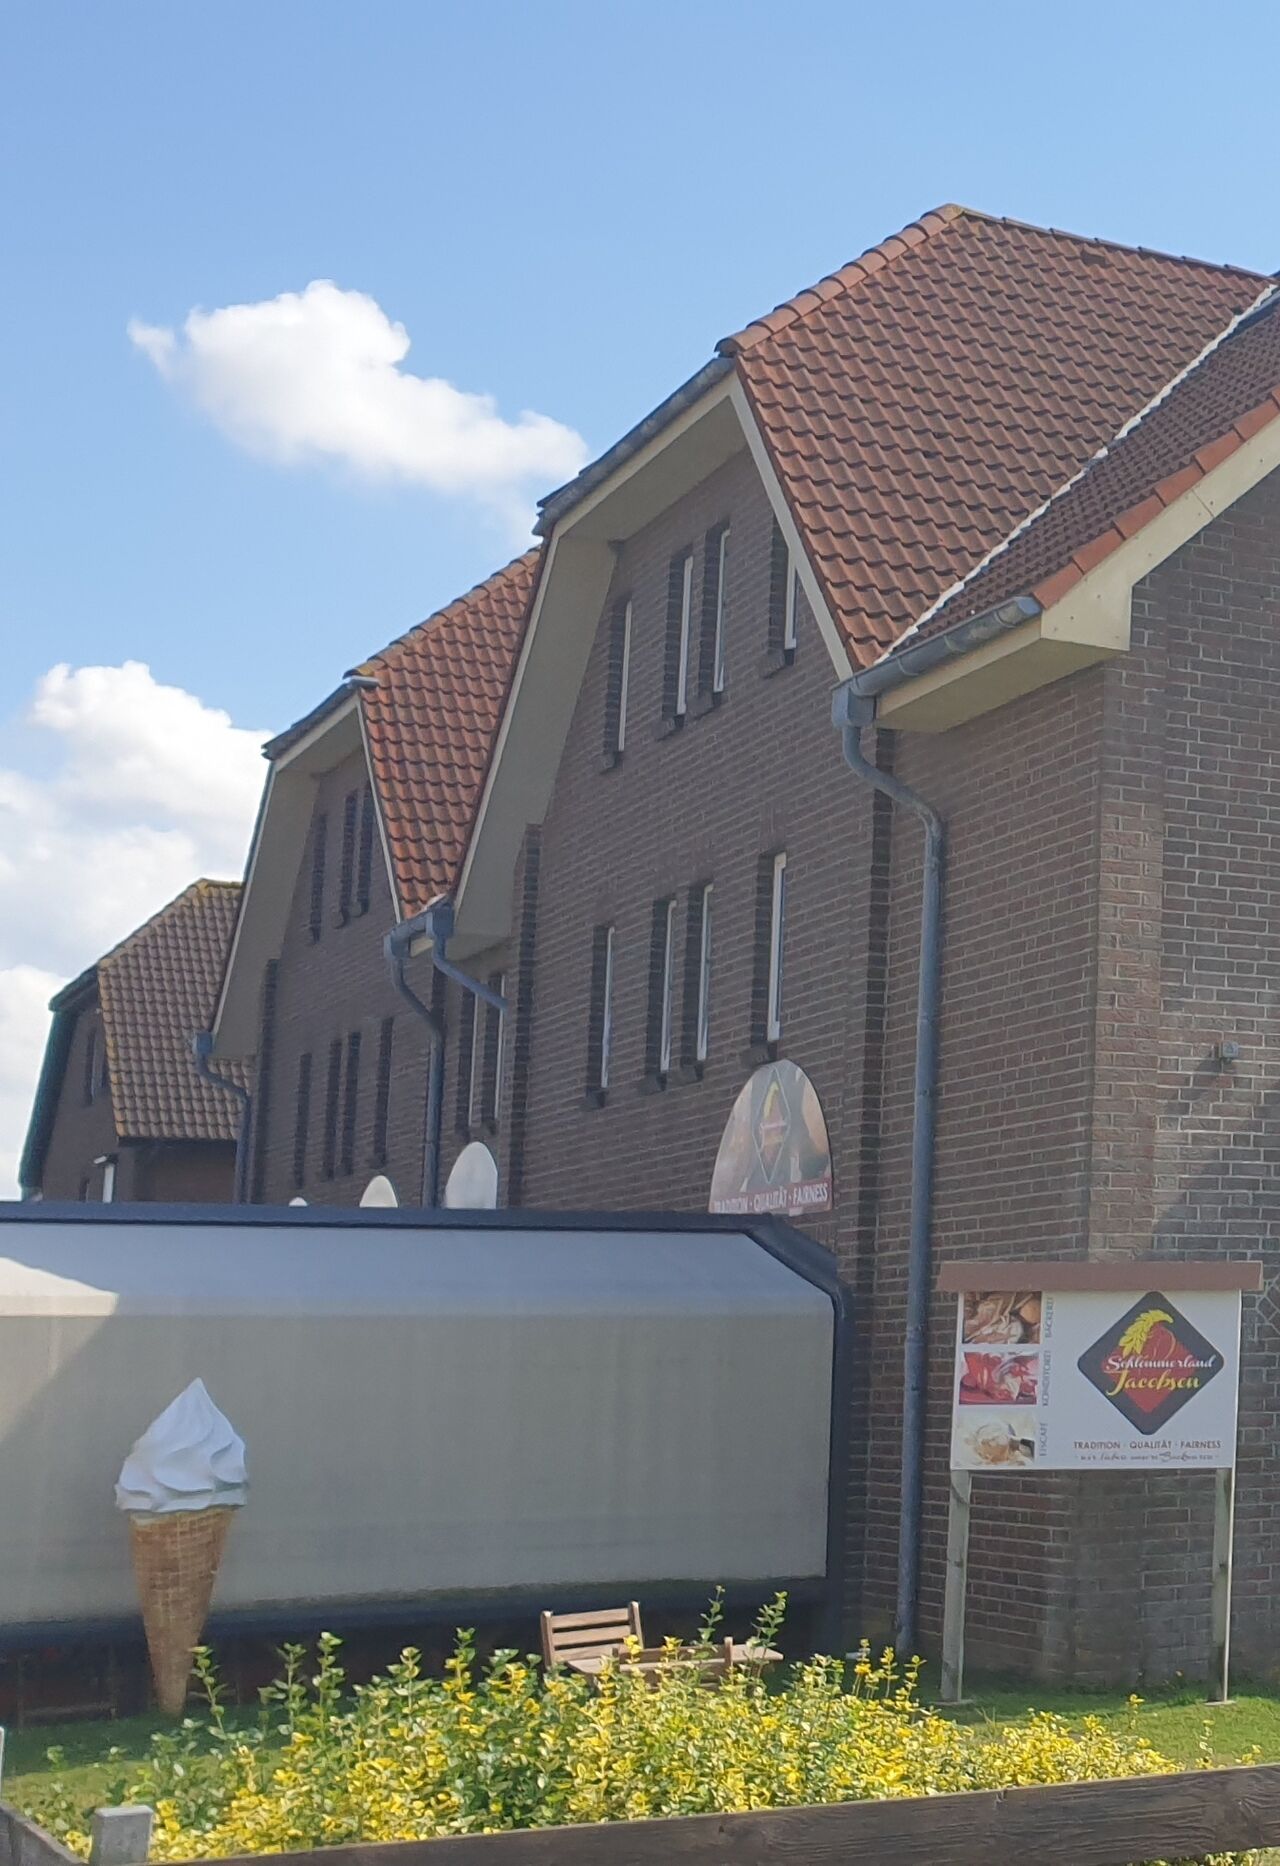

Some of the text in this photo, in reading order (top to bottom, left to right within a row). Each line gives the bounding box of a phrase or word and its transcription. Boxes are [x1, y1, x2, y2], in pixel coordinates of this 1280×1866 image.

[1106, 1369, 1200, 1396] Jacobsen
[1074, 1441, 1120, 1449] TRADITION
[1180, 1440, 1221, 1449] FAIRNESS
